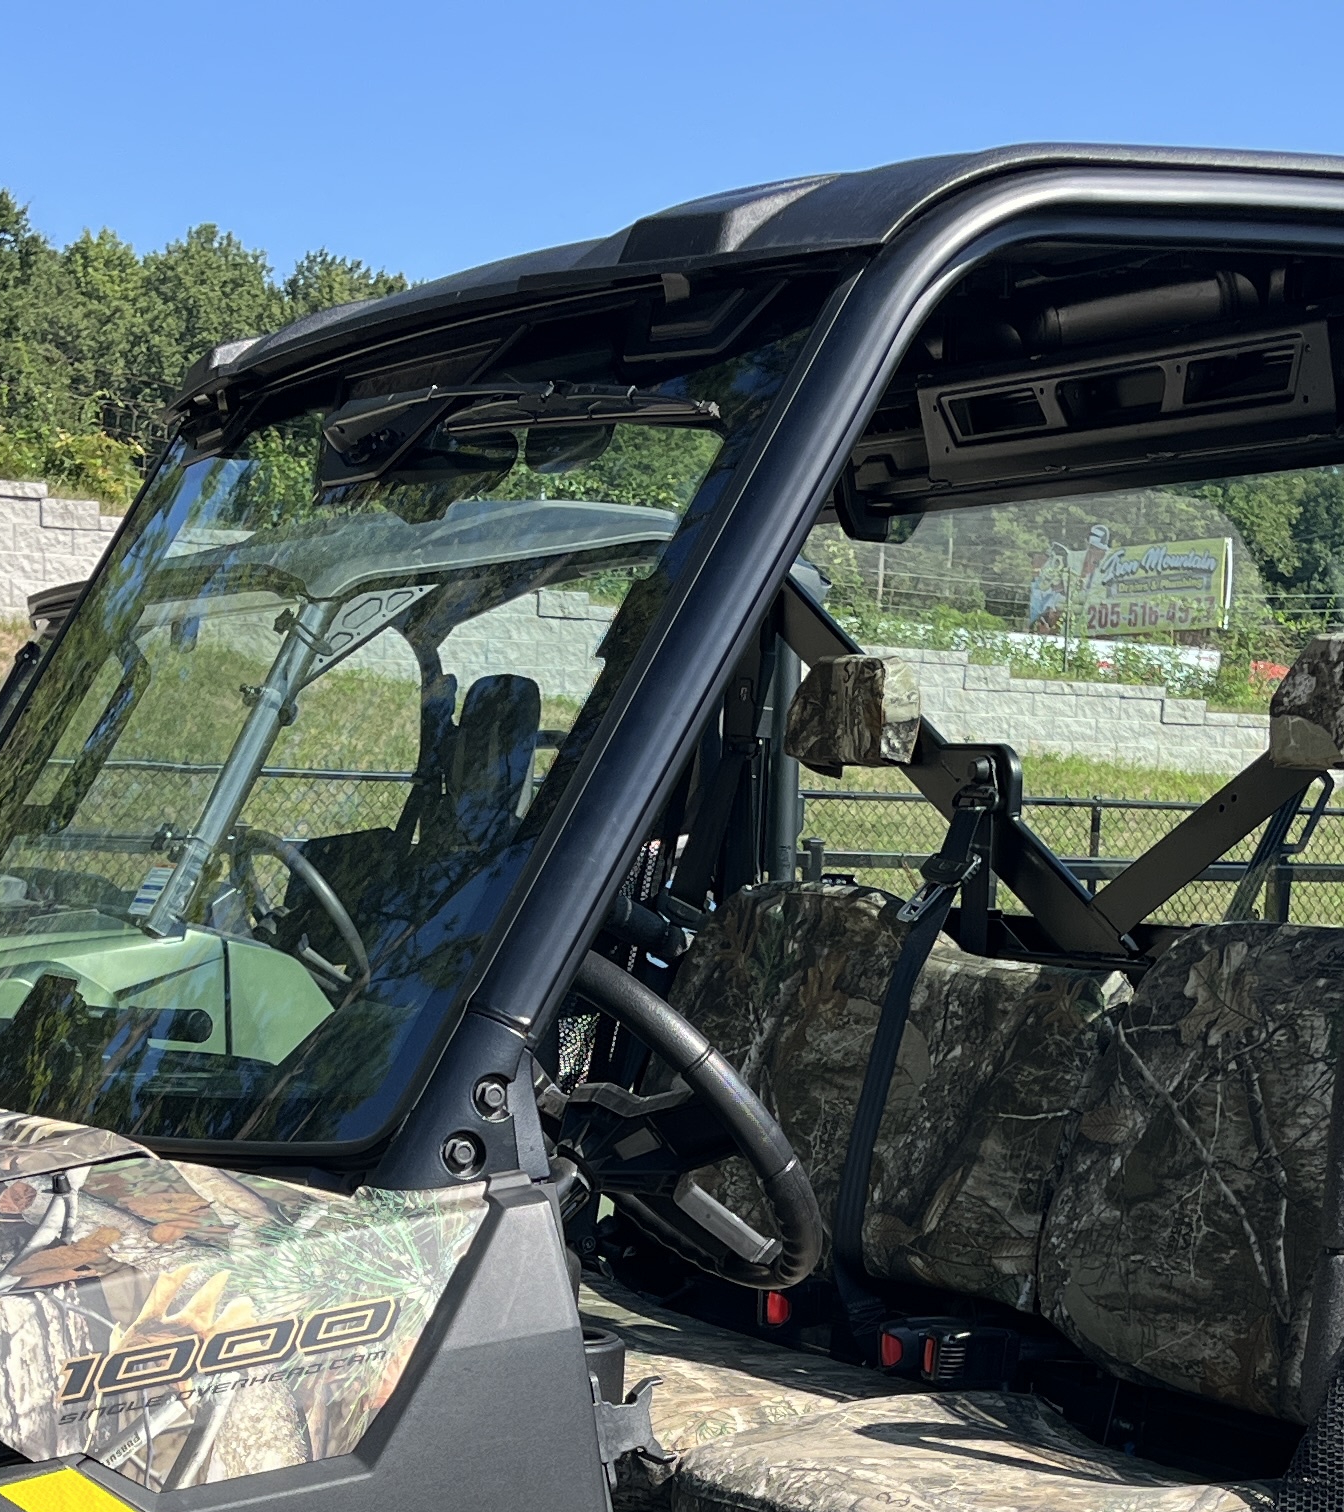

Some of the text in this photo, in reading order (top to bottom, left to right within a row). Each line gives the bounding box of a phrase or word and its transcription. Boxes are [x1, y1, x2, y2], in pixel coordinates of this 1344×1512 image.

[1100, 545, 1218, 585] Iron Mountain
[57, 1295, 402, 1405] 1000
[58, 1351, 387, 1426] SINGLE OVERHEAD CAM
